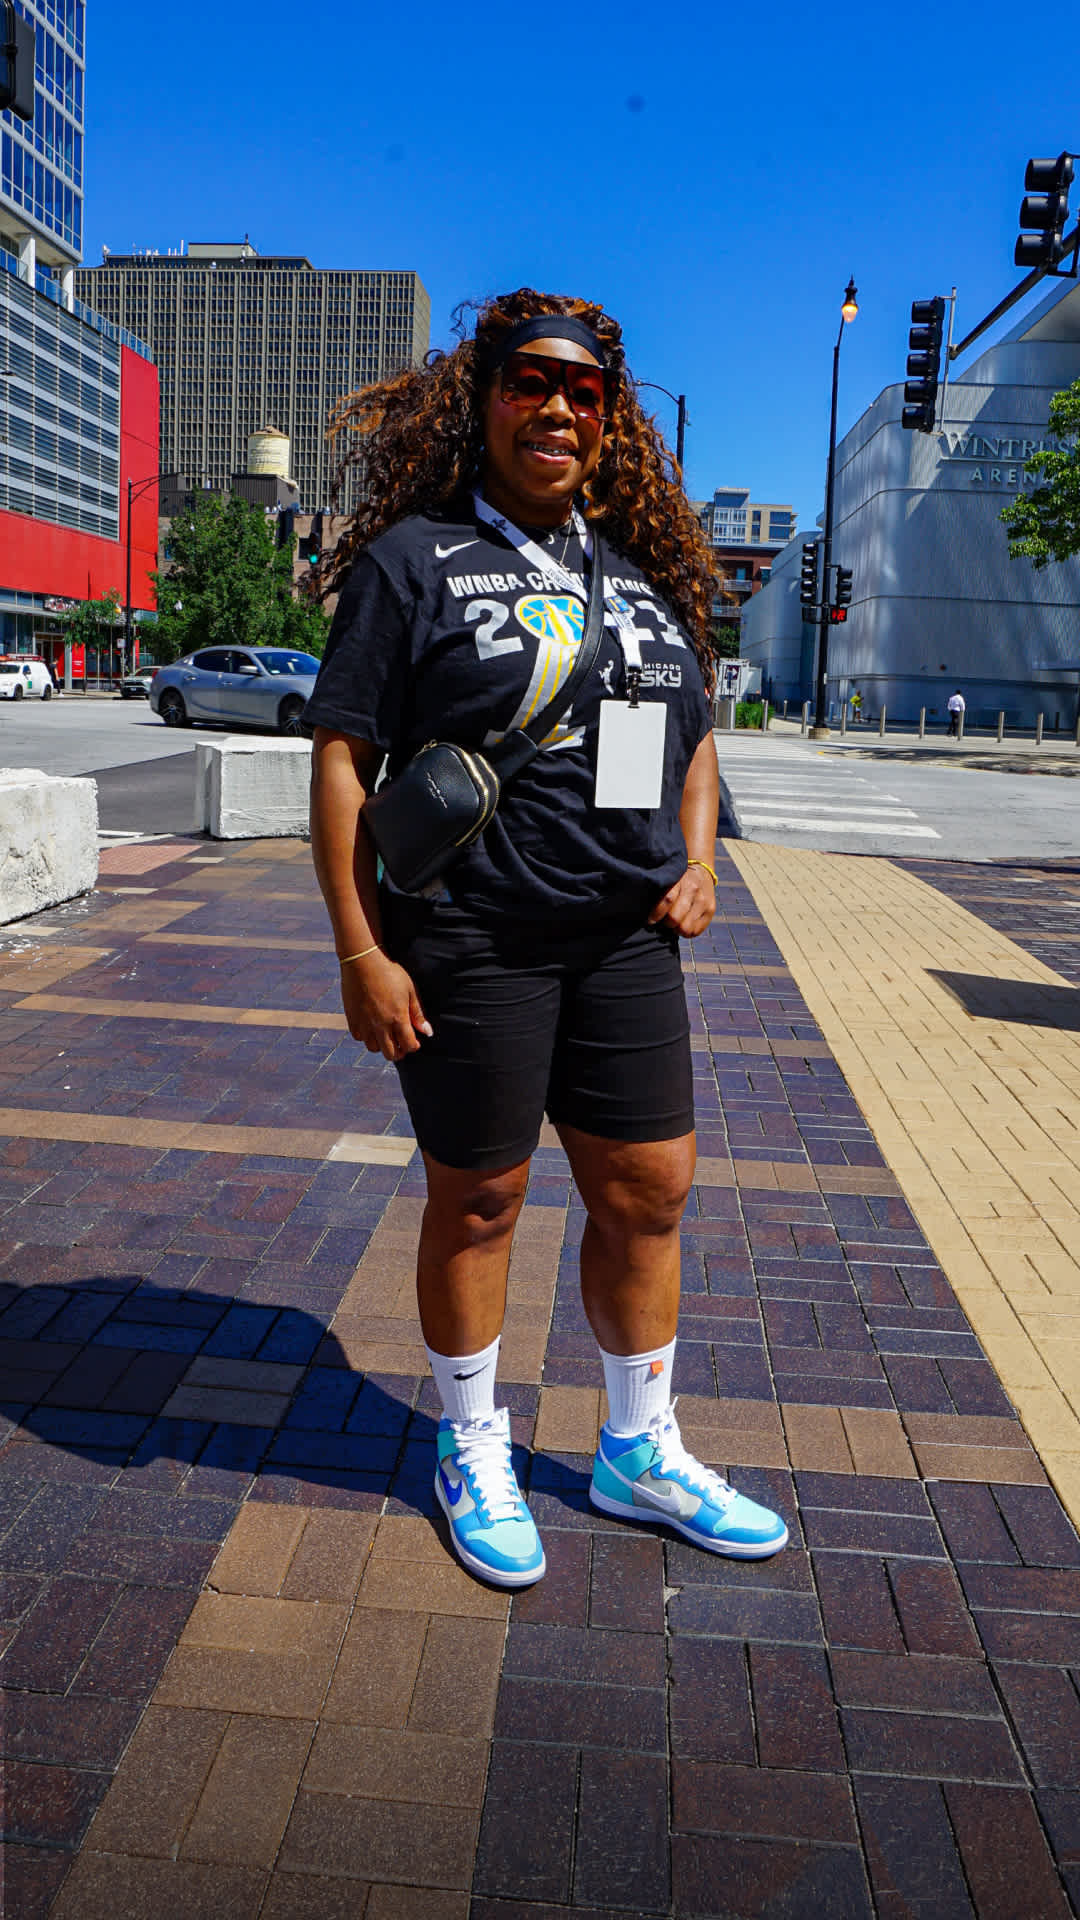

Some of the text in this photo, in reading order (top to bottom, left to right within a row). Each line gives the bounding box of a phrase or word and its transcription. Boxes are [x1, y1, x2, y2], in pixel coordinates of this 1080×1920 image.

[944, 432, 1070, 458] WINTRUS
[447, 573, 525, 597] WNBA
[638, 670, 682, 687] SKY
